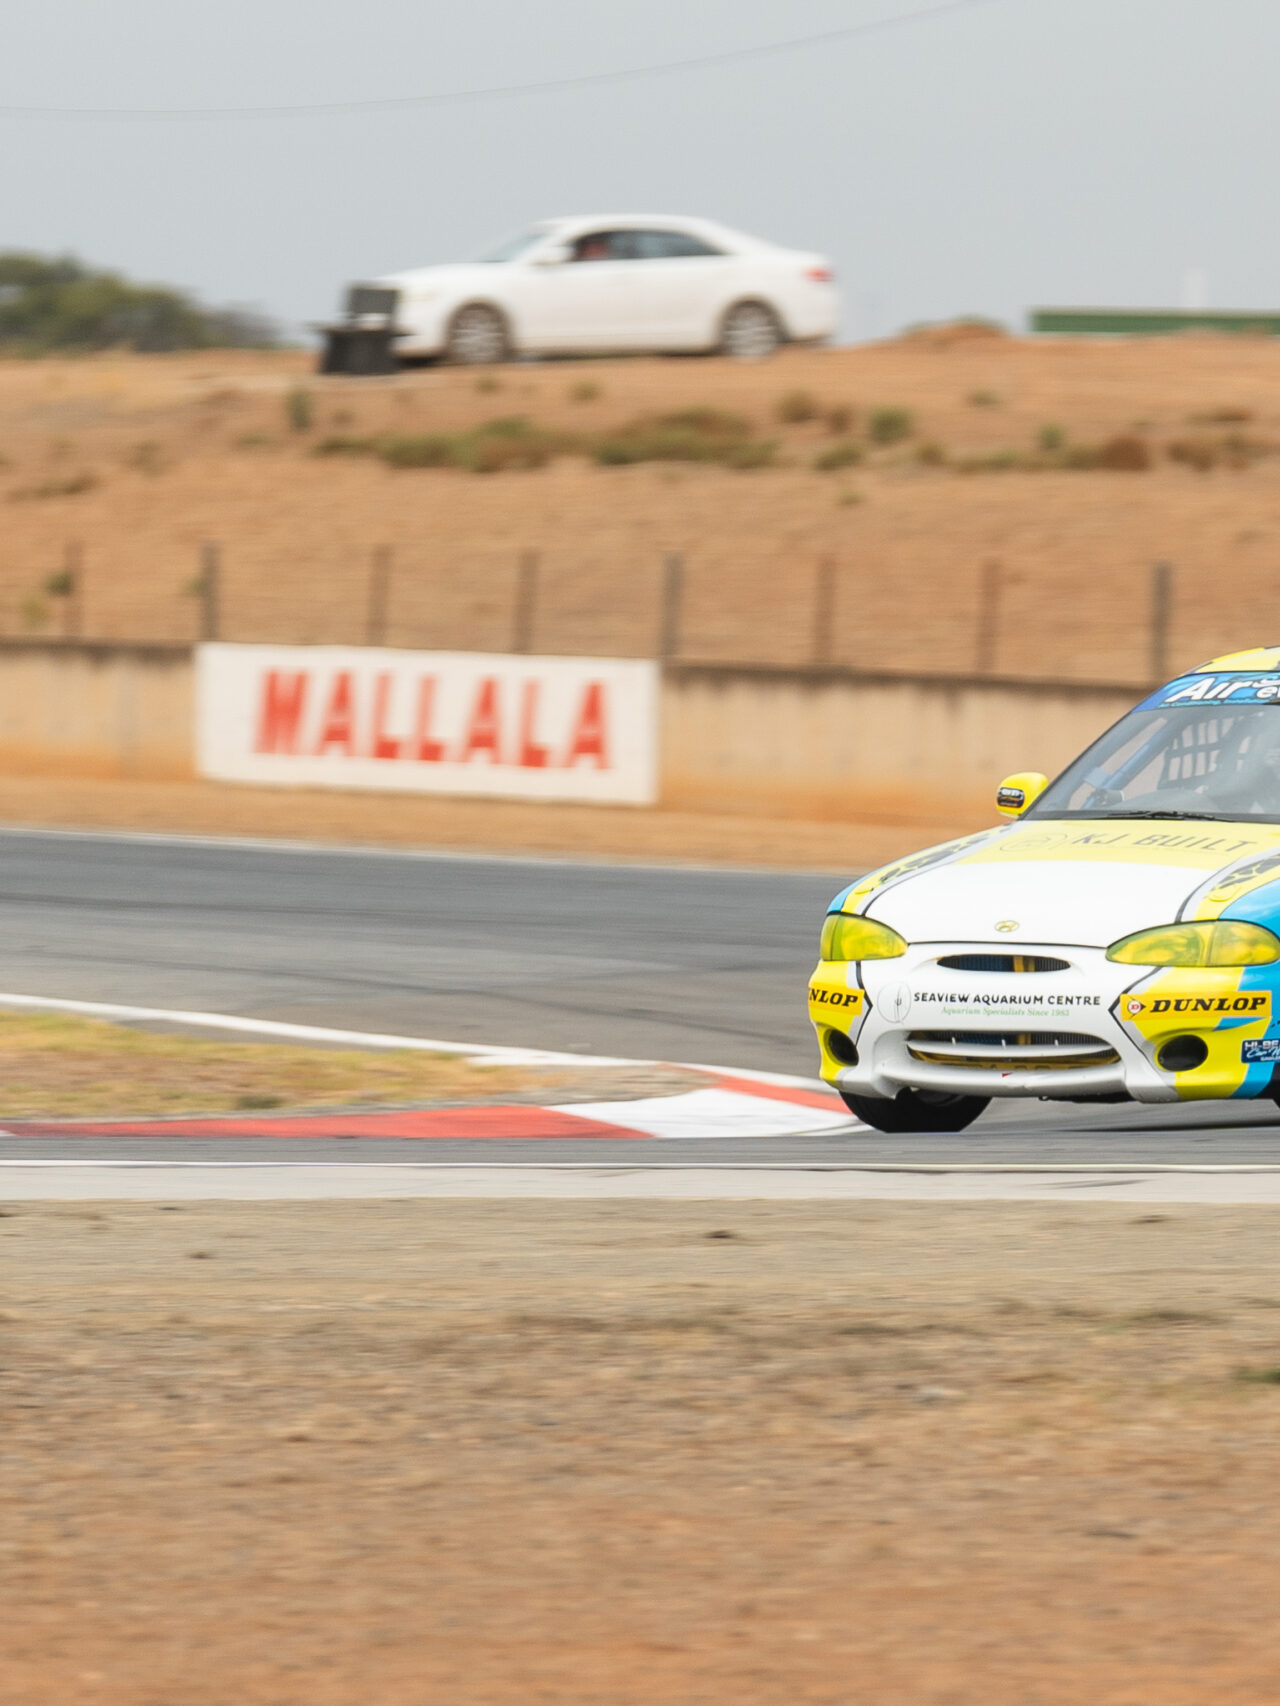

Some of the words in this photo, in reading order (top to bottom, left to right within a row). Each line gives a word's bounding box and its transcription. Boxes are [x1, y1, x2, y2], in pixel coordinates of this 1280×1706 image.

[255, 667, 612, 770] MALLALA
[1072, 832, 1131, 845] KJ
[1133, 834, 1257, 852] BUILT
[810, 988, 858, 1007] NLOP
[913, 992, 970, 1003] SEAVIEW
[973, 994, 1043, 1006] AQUARIUM
[1047, 995, 1101, 1006] CENTRE
[1150, 997, 1267, 1012] DUNLOP
